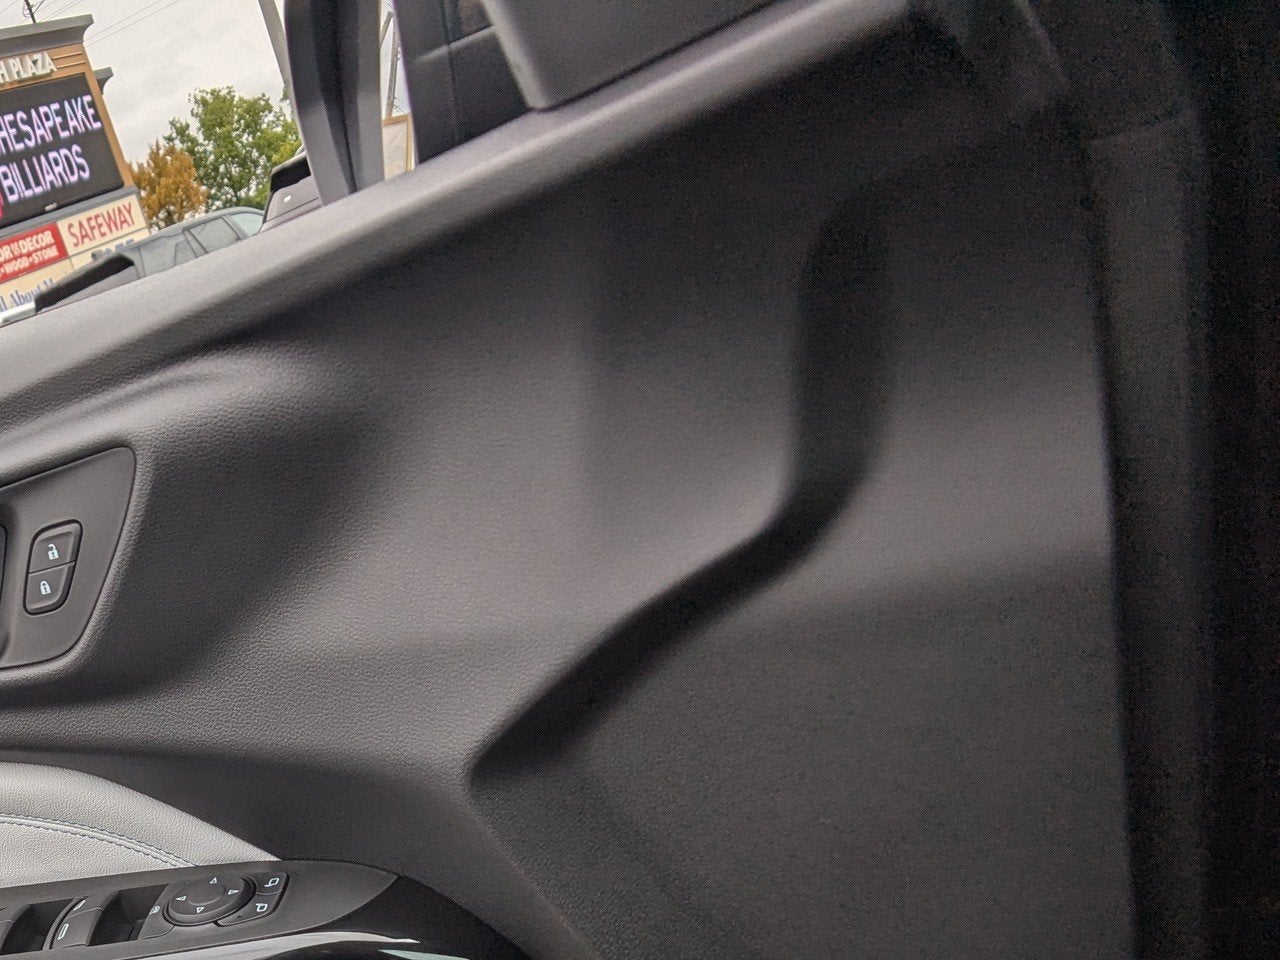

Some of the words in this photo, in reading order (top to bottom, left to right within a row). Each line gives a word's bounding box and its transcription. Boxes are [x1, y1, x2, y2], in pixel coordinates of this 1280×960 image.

[9, 51, 58, 80] PLAZA
[67, 202, 135, 248] SAFEWAY
[18, 230, 56, 254] DECOR
